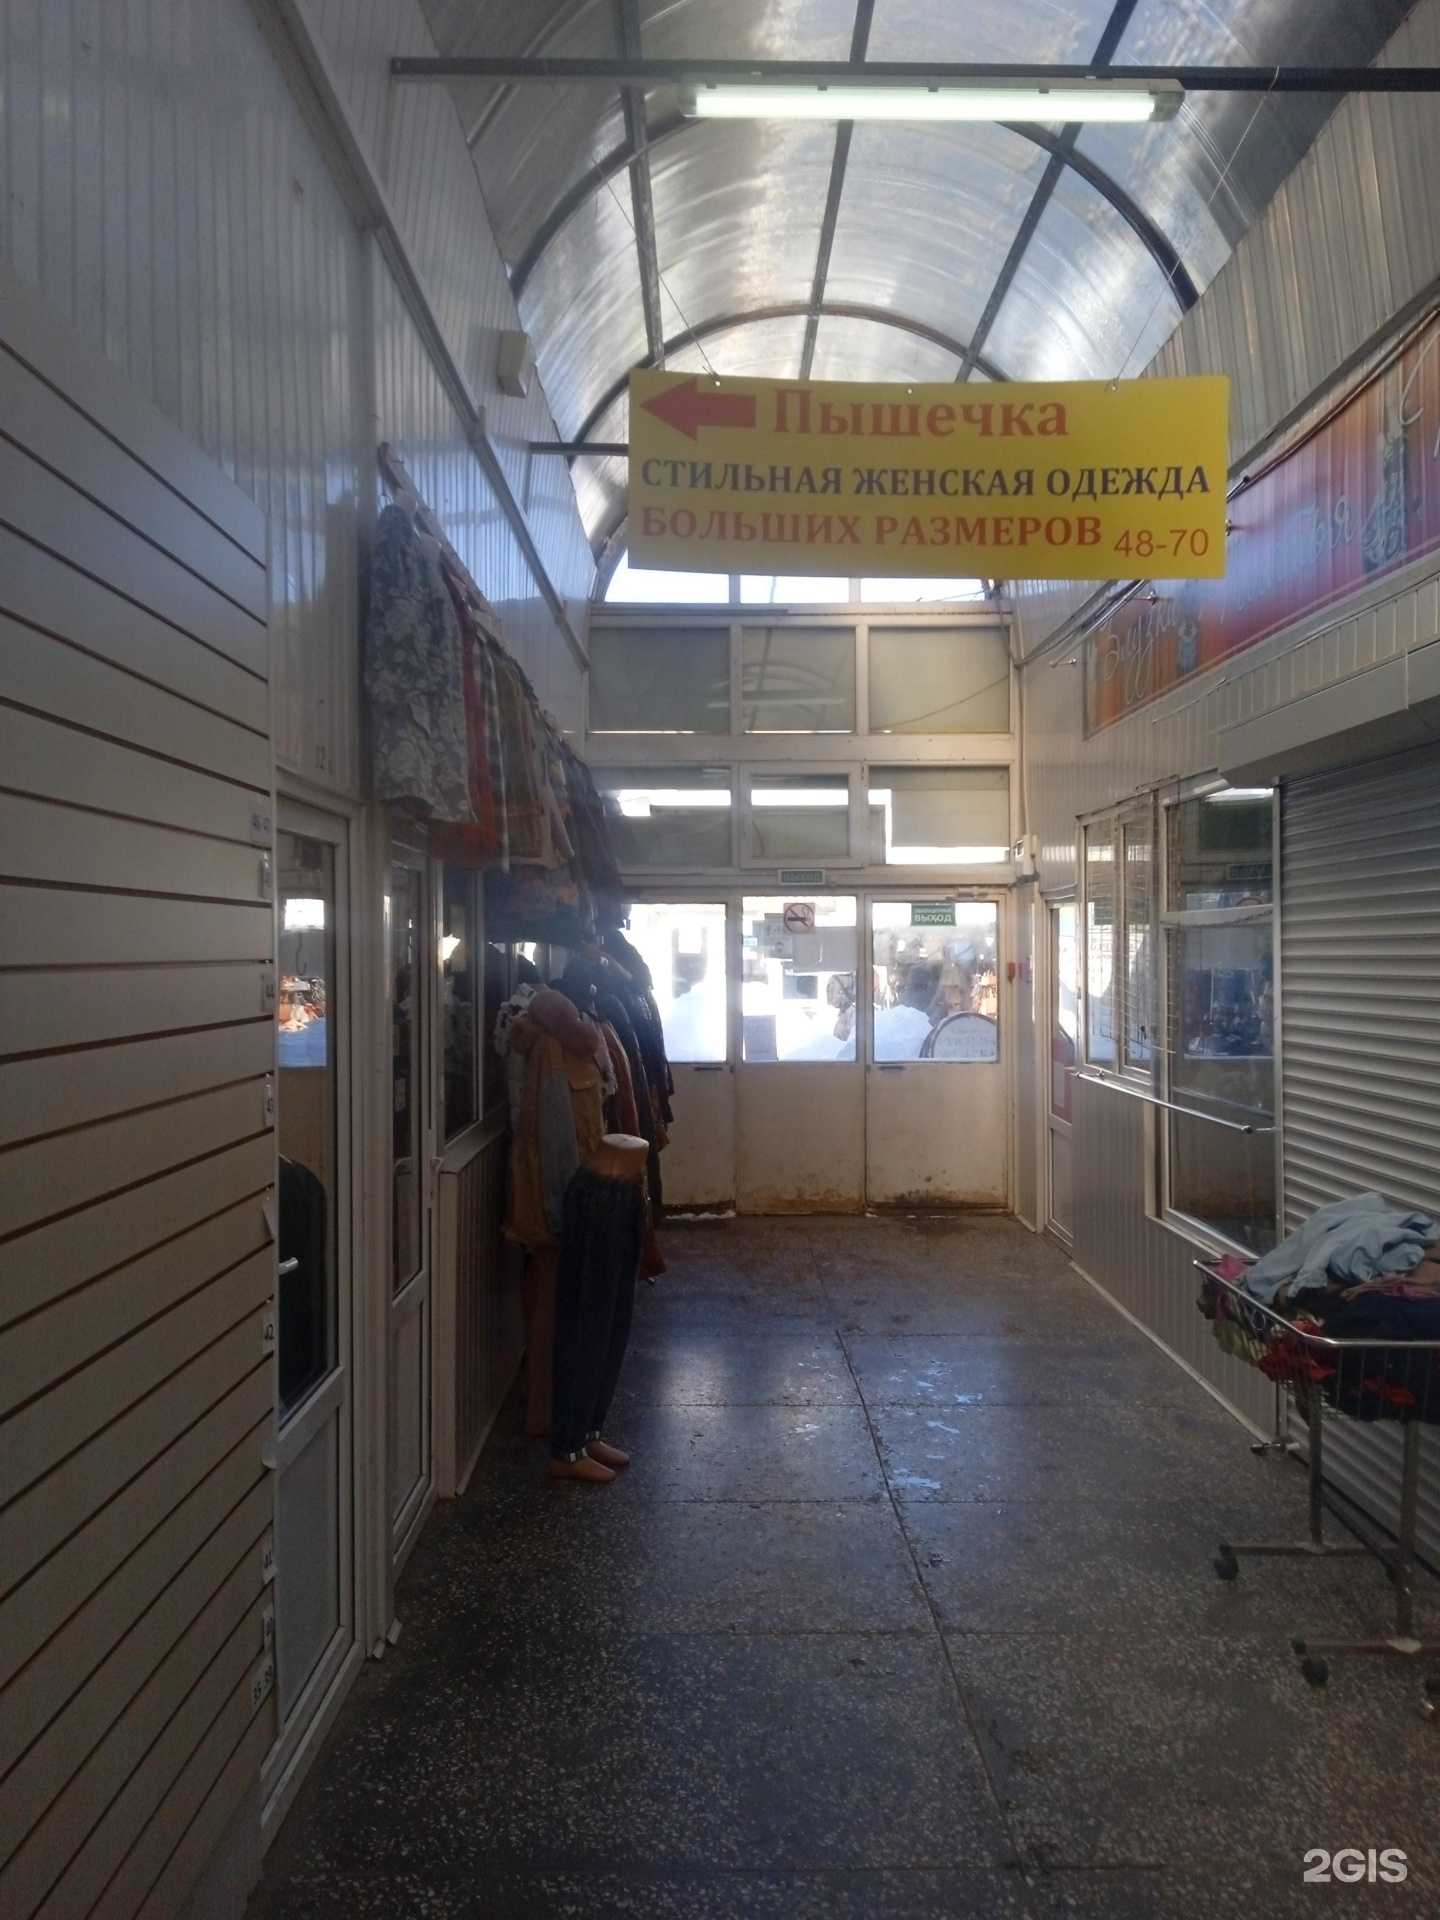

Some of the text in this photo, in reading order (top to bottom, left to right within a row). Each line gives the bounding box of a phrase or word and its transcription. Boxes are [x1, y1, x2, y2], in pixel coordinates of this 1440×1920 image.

[773, 388, 1068, 437] Пышечка
[641, 457, 1210, 502] СТИЛЬНАЯ ЖЕНСКАЯ ОДЕЖДА
[640, 506, 1210, 558] БОЛЬШИХ РАЗМЕРОВ 48-70
